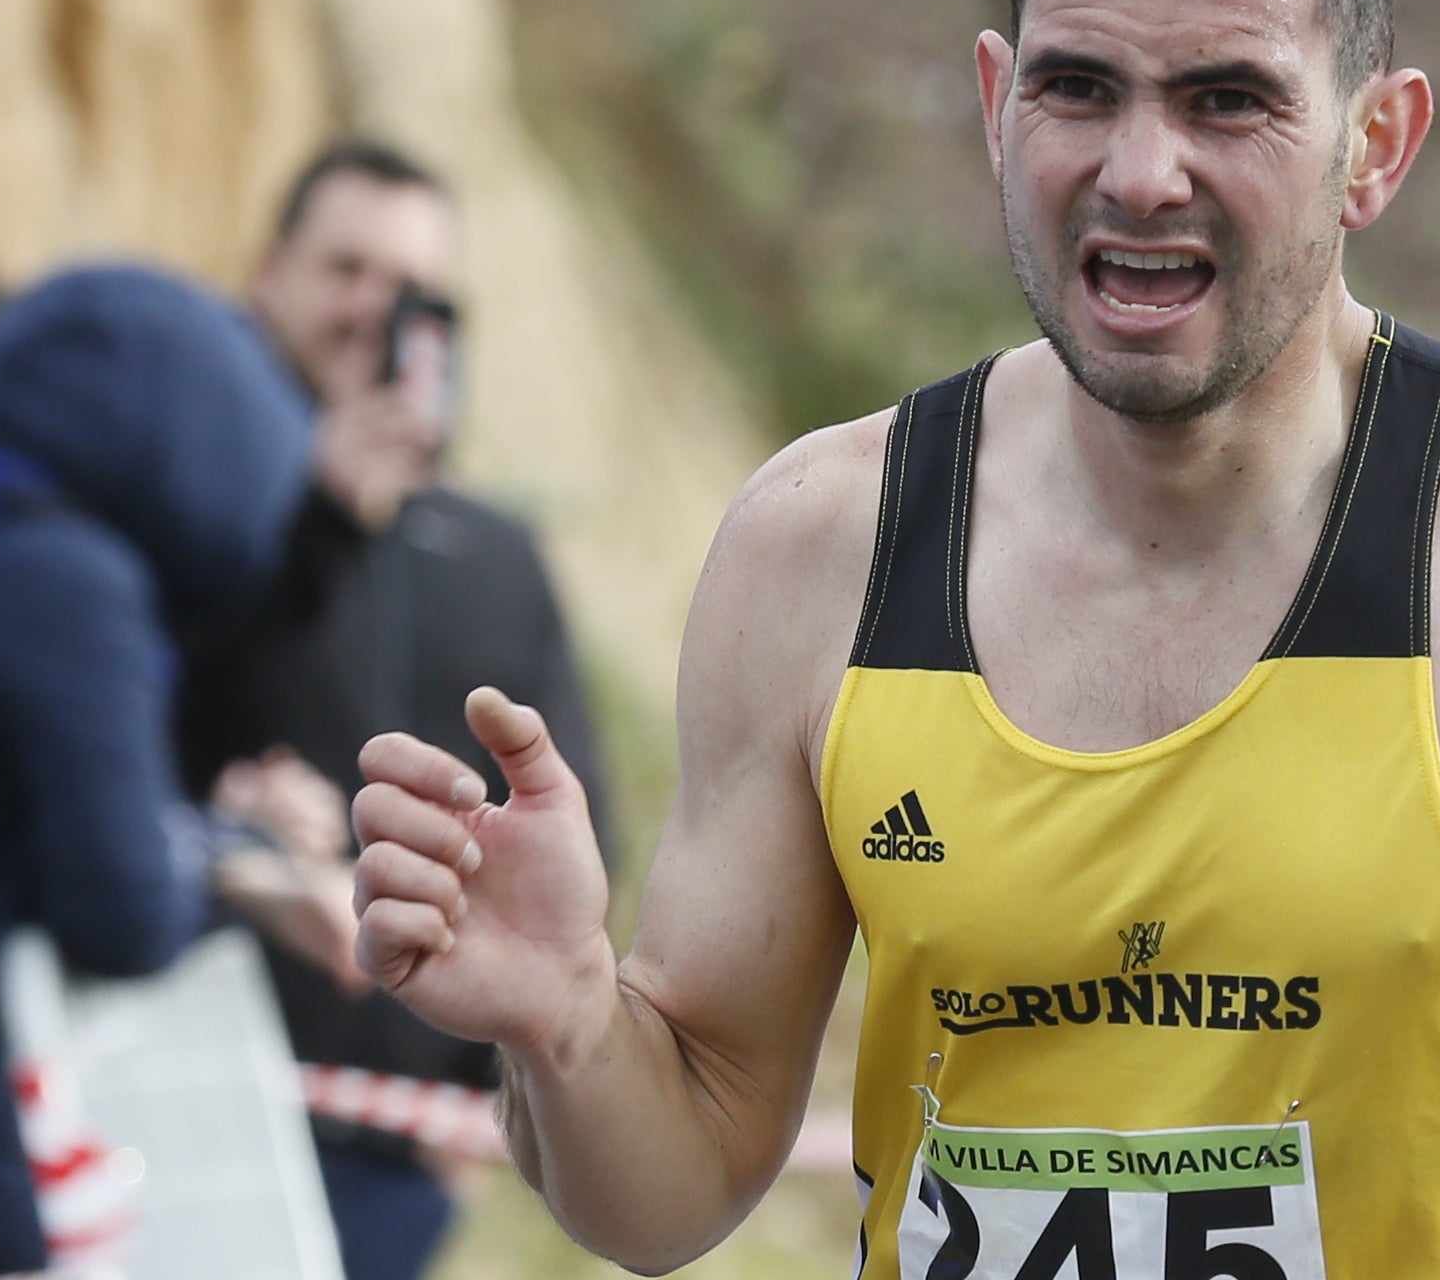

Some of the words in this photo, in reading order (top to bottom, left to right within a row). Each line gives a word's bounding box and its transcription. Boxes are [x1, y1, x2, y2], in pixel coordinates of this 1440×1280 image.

[862, 834, 945, 863] adidas
[945, 1144, 1040, 1174] VILLA
[1049, 1148, 1096, 1174] DE
[1106, 1143, 1301, 1176] SIMANCAS
